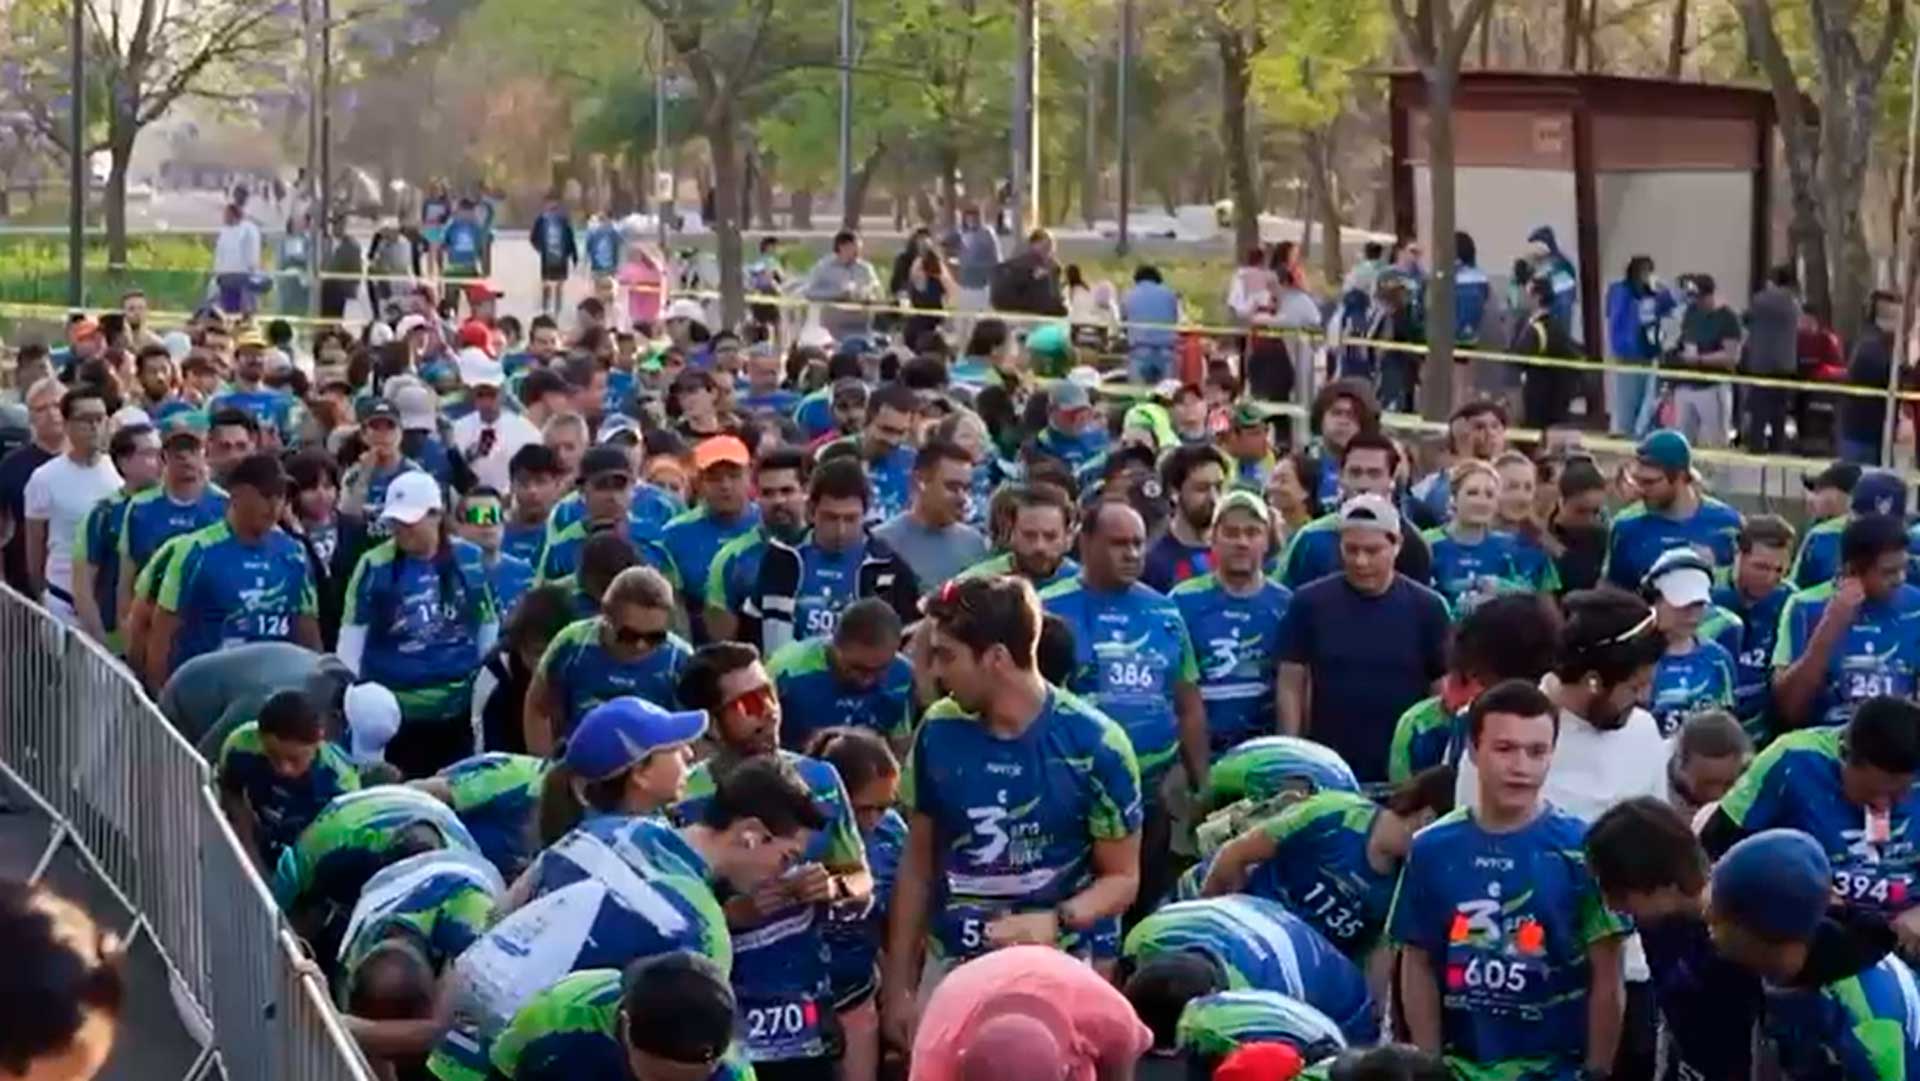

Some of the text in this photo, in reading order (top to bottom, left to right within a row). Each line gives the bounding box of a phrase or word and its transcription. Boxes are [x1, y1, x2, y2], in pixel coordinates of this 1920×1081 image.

[258, 614, 290, 636] 126
[1109, 662, 1153, 687] 386
[1832, 871, 1889, 902] 394
[1304, 882, 1364, 937] 1135
[1464, 957, 1526, 992] 605
[748, 1003, 803, 1037] 270
